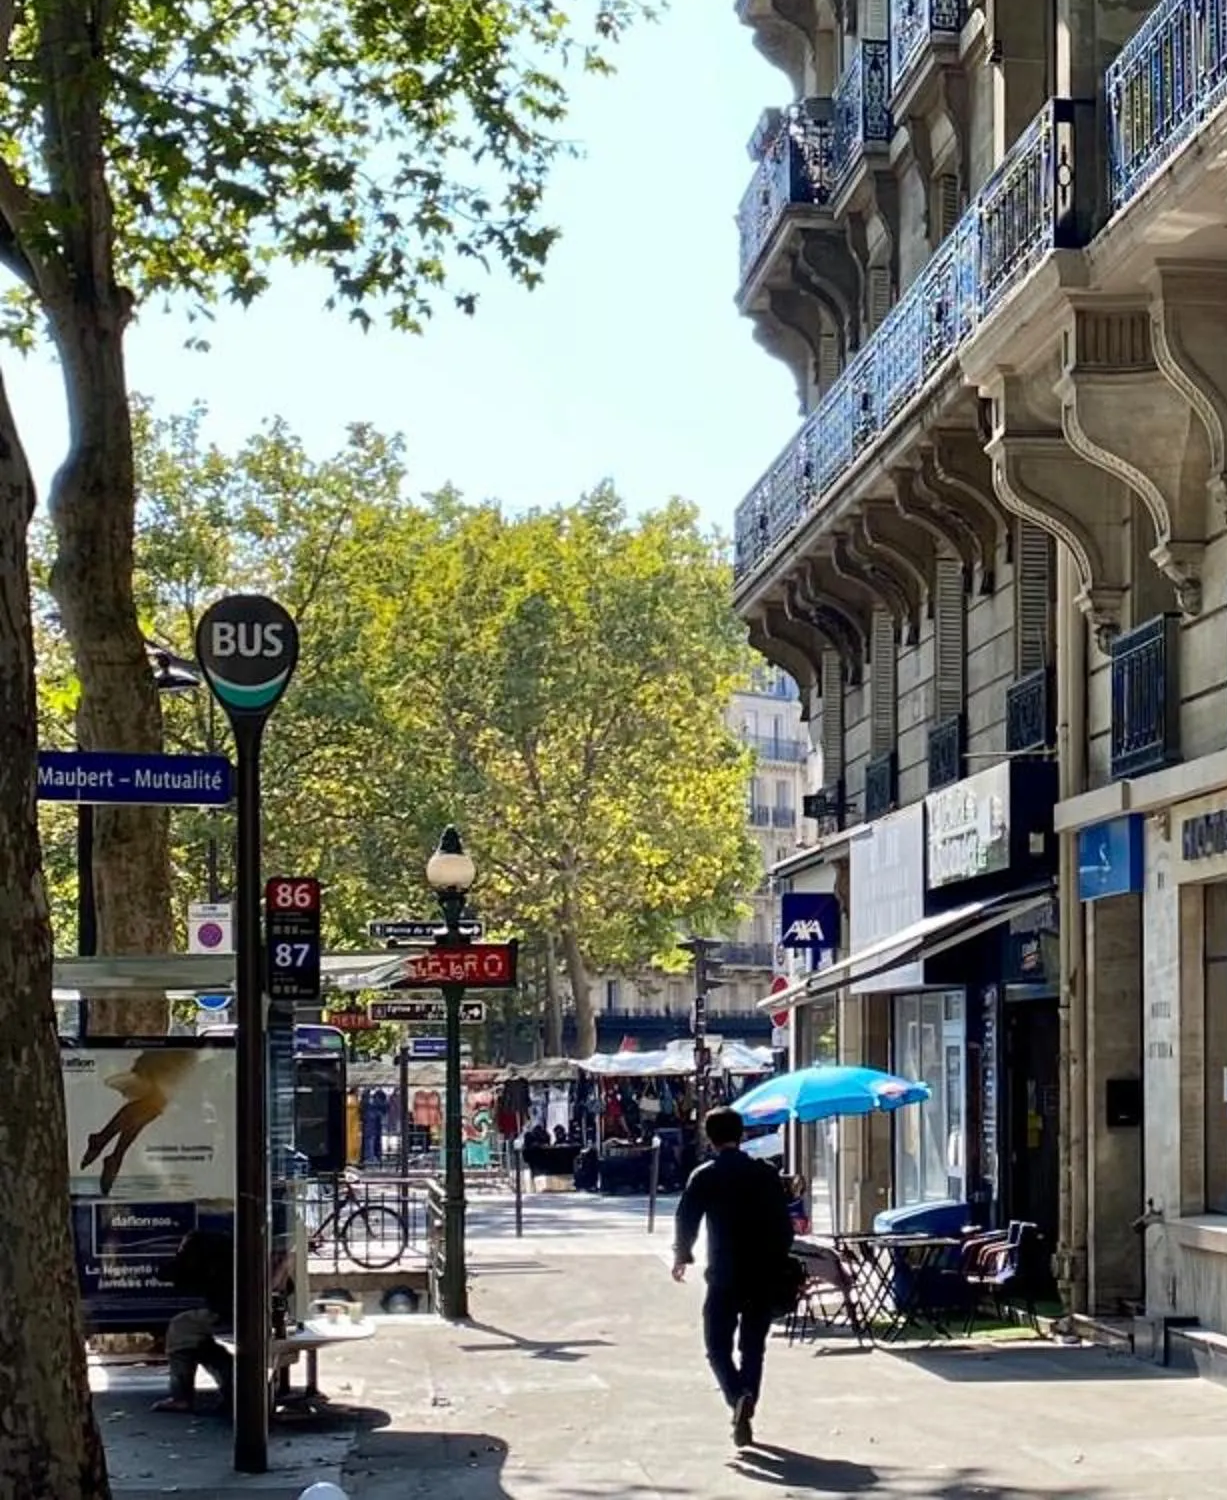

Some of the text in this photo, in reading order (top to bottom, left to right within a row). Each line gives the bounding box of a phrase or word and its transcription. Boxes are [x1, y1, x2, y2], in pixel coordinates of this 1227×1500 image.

[212, 622, 283, 657] BUS
[37, 766, 115, 788] Maubert
[134, 768, 223, 790] Mutualité
[276, 883, 311, 907] 86
[783, 919, 825, 941] AXA
[275, 943, 310, 967] 87
